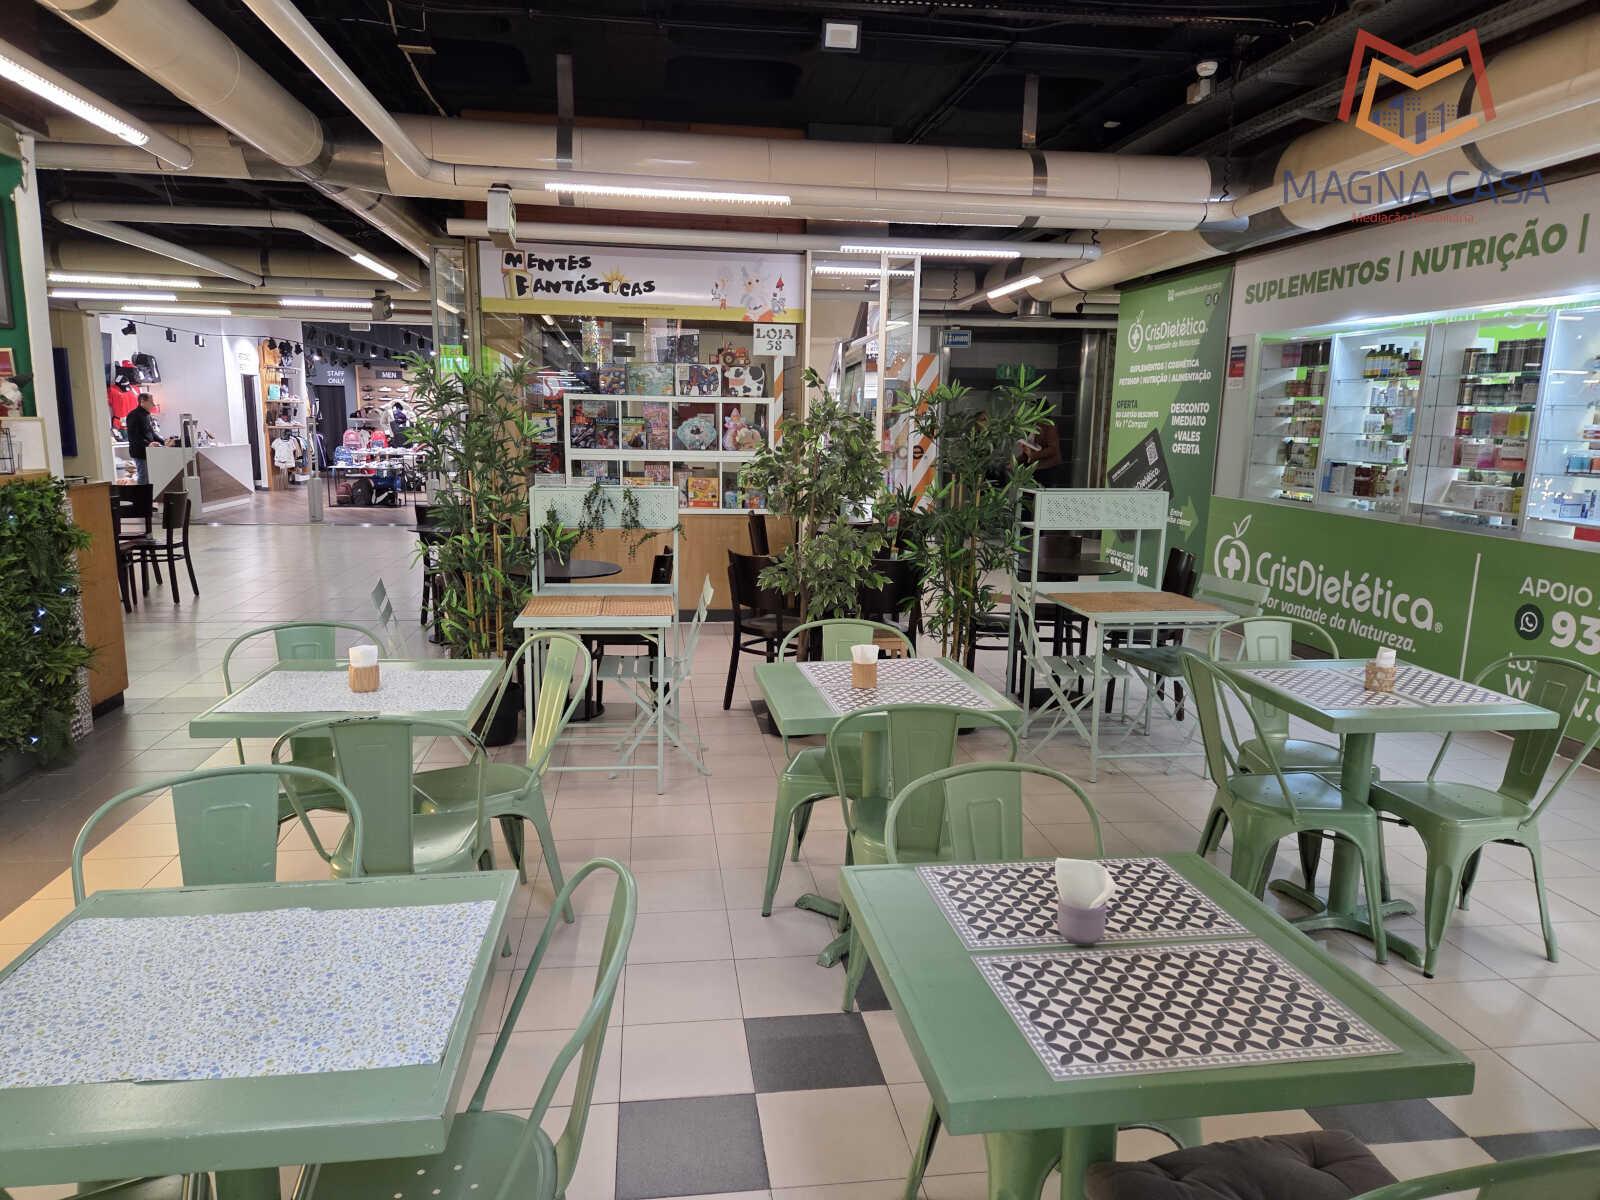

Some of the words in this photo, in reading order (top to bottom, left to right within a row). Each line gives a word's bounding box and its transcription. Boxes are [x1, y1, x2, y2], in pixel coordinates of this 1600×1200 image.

[504, 252, 592, 271] MENTES
[1245, 256, 1391, 304] SUPLEMENTOS
[1410, 217, 1568, 276] NUTRIÇÃO
[755, 328, 794, 340] LOJA
[767, 340, 782, 351] 58
[381, 371, 397, 379] MEN
[1116, 400, 1138, 409] OFERTA
[1170, 402, 1210, 413] DESCONTO
[1171, 415, 1207, 426] IMEDIATO
[1172, 443, 1200, 455] OFERTA
[1519, 576, 1593, 607] APOIO
[1281, 600, 1328, 625] vontade
[1329, 612, 1347, 632] da
[1348, 618, 1417, 653] Natureza.
